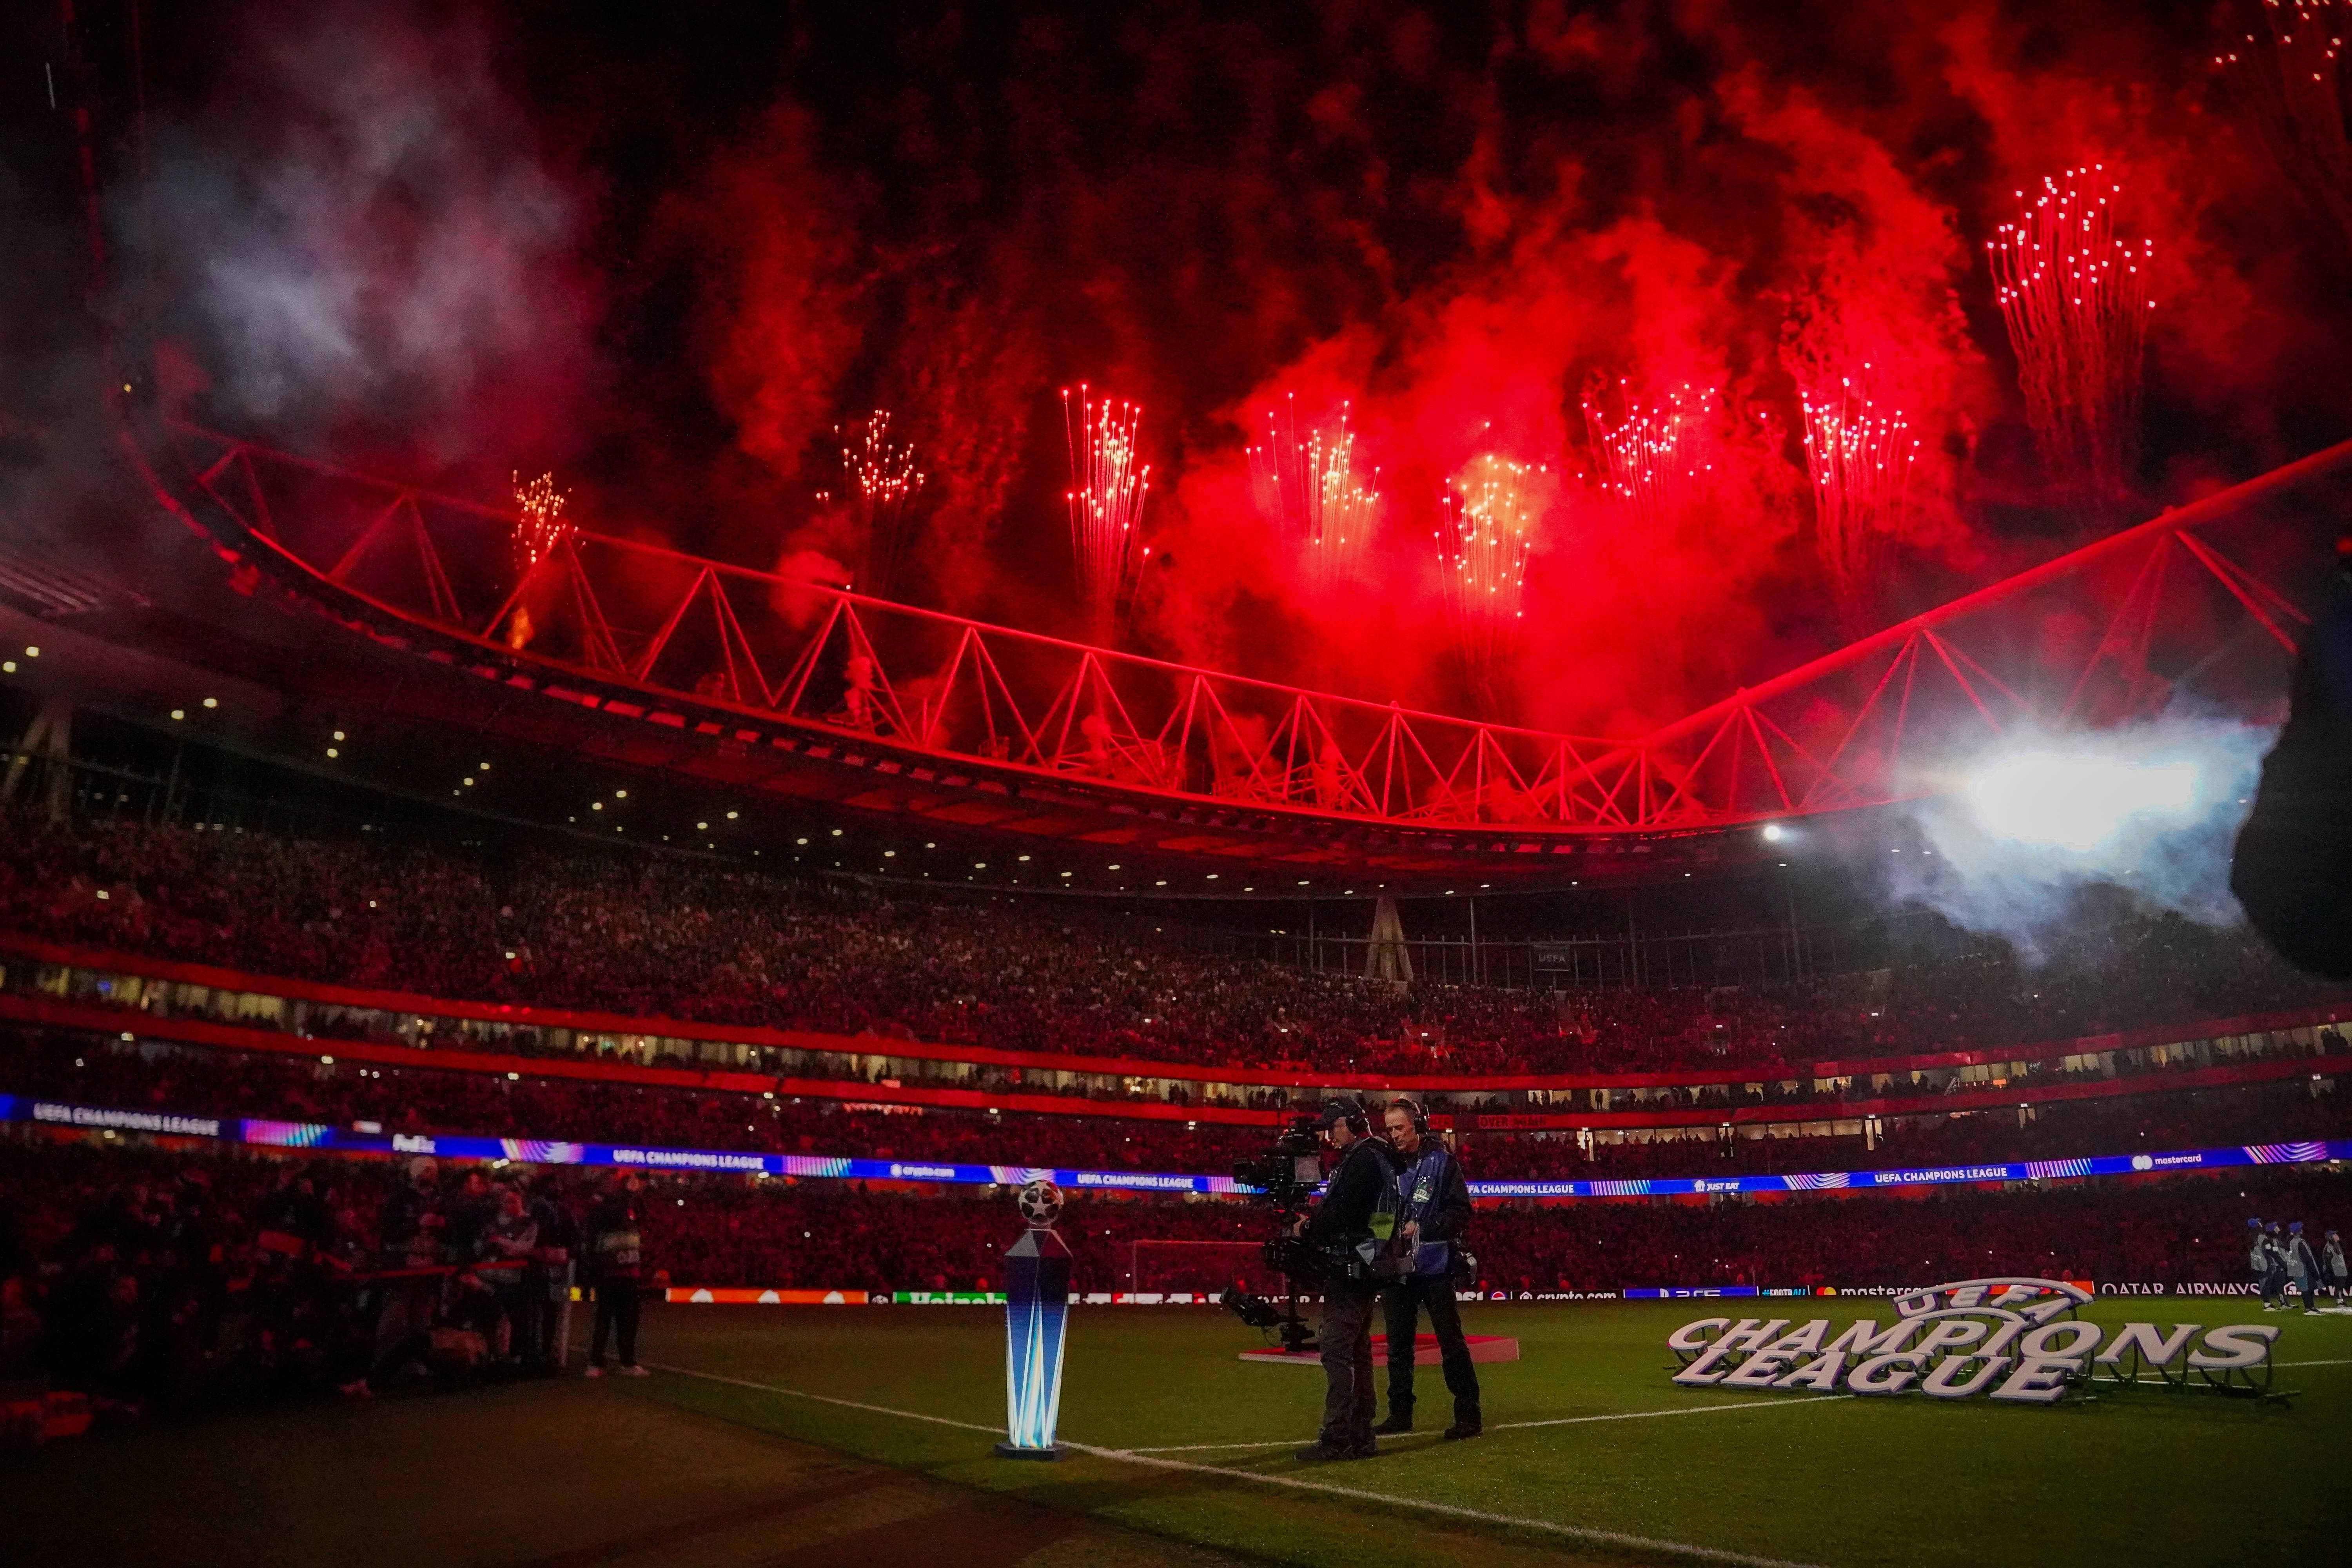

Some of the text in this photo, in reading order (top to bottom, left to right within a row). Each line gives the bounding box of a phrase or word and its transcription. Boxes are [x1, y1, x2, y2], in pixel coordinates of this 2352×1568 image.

[163, 1116, 220, 1136] LEAGUE
[1479, 1117, 1508, 1127] OVER
[613, 1149, 764, 1170] UEFA CHAMPIONS LEAGUE
[2155, 1154, 2201, 1165] mastercard
[1078, 1174, 1194, 1188] UEFA CHAMPIONS LEAGUE
[1875, 1167, 2007, 1183] UEFA CHAMPIONS LEAGUE
[1481, 1185, 1536, 1193] CHAMPIONS
[1537, 1185, 1574, 1193] LEAGUE
[1707, 1183, 1724, 1191] JUST
[2176, 1283, 2261, 1295] AIRWAYS
[1896, 1285, 2071, 1325] UEFA
[1667, 1317, 2282, 1369] CHAMPIONS
[1672, 1347, 2084, 1403] LEAGUE
